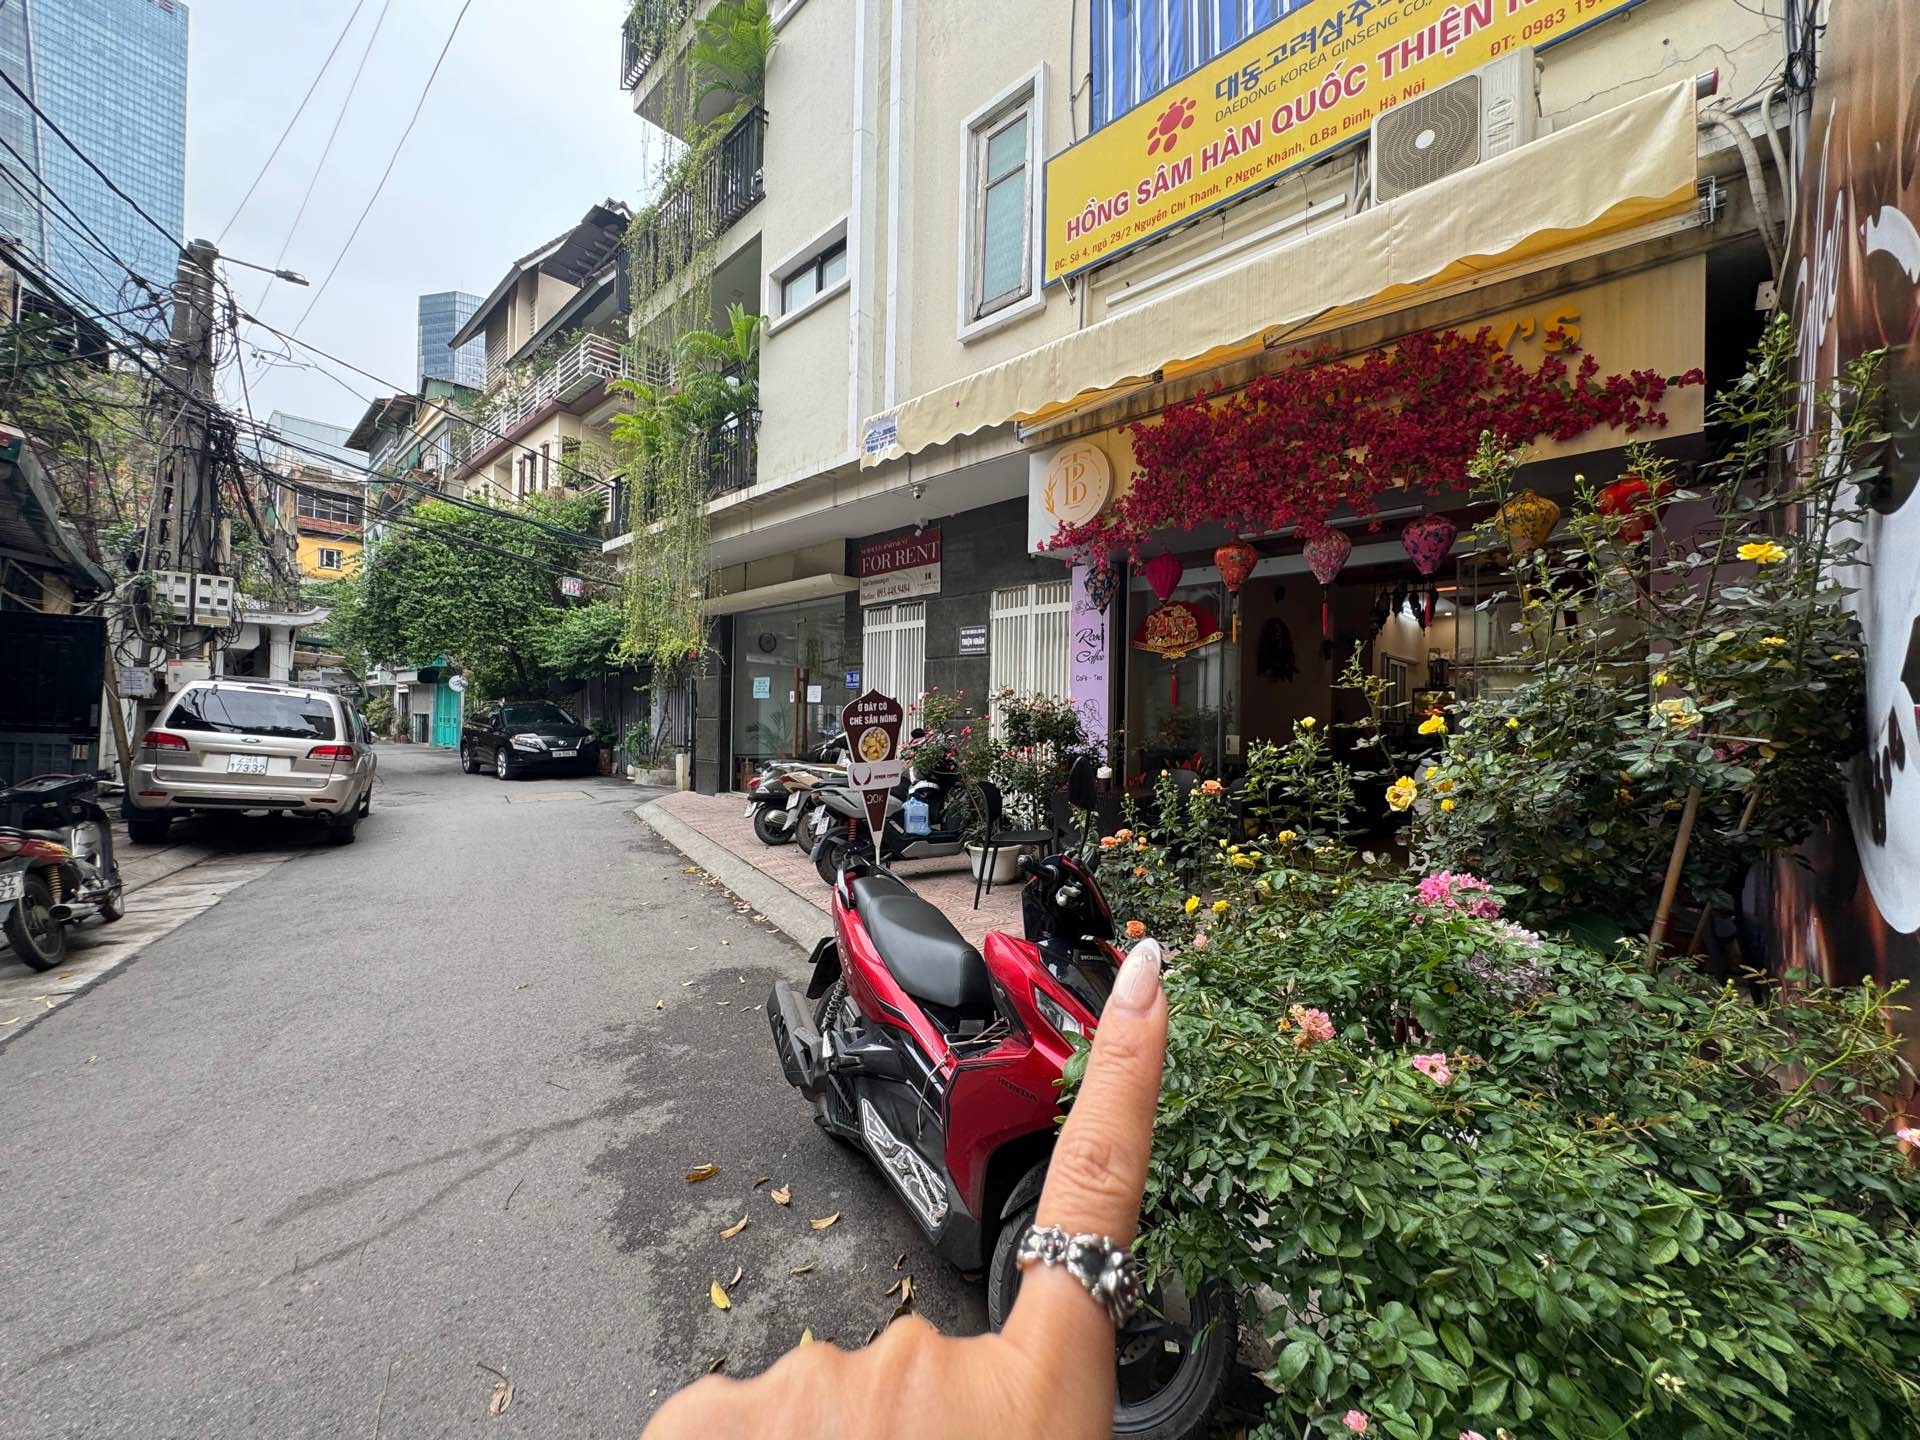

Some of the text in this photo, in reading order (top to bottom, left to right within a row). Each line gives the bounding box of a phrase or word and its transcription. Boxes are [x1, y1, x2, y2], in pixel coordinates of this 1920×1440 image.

[1215, 81, 1276, 122] DAEDONG
[1280, 54, 1327, 88] KOREA
[1332, 11, 1398, 57] GINSENG
[1490, 34, 1516, 57] ĐT:
[1522, 8, 1567, 40] 0983
[1066, 0, 1492, 242] HỒNG SÂM HÀN QUỐC THIỆN
[1054, 257, 1068, 271] ĐC:
[1110, 226, 1131, 242] 29/2
[1134, 208, 1168, 233] Nguyễn
[1188, 184, 1221, 204] Thanh,
[1225, 161, 1263, 187] P.Ngọc
[1267, 141, 1305, 167] Khánh,
[1309, 125, 1338, 147] Q.Ba
[1342, 107, 1374, 129] Đình,
[1379, 92, 1397, 112] Hà
[1403, 78, 1426, 100] Nội
[862, 552, 892, 574] FOR
[895, 541, 941, 567] RENT
[996, 1077, 1040, 1104] HONDA
